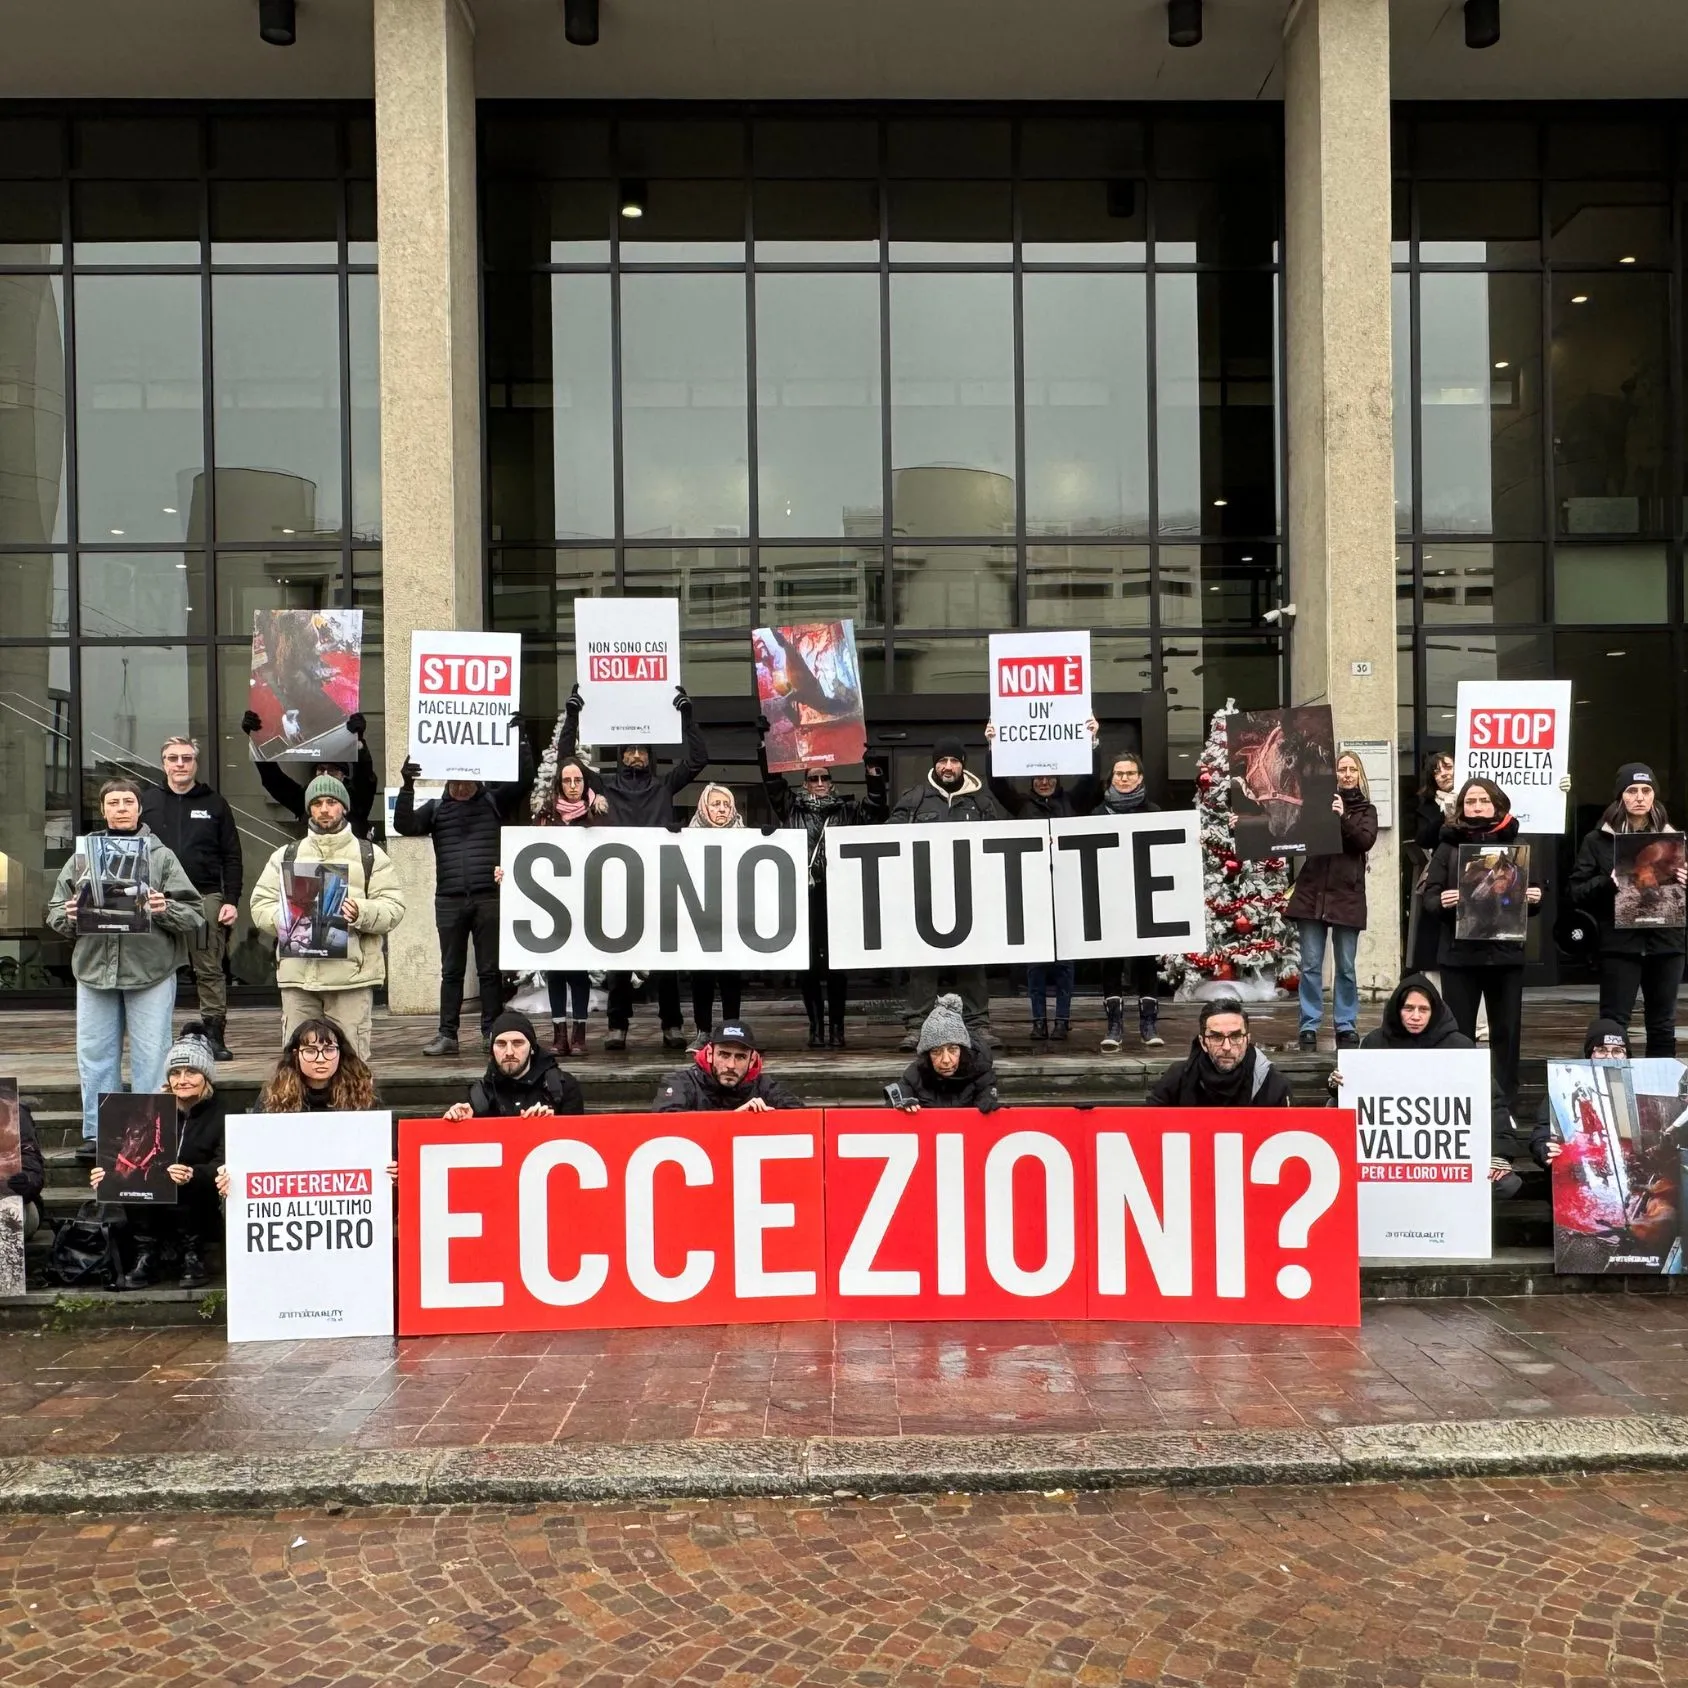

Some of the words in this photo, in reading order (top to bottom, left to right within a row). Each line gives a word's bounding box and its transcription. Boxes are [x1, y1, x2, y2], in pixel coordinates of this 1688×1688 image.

[588, 641, 610, 653] NON
[614, 641, 642, 653] SONO
[645, 641, 668, 653] CASI
[423, 657, 508, 692] STOP
[592, 657, 665, 680] ISOLATI
[1001, 663, 1055, 694] NON
[1063, 655, 1080, 692] È
[418, 700, 512, 716] MACELLAZIONI
[417, 719, 511, 747] CAVALLI
[999, 723, 1084, 742] ECCEZIONE
[1472, 712, 1552, 745] STOP
[1494, 772, 1552, 785] MACELLI
[512, 842, 798, 954] SONO
[839, 828, 1191, 951] TUTTE
[1357, 1096, 1472, 1126] NESSUN
[1358, 1129, 1471, 1159] VALORE
[251, 1172, 369, 1196] SOFFERENZA
[1361, 1166, 1385, 1179] PER
[1388, 1166, 1403, 1179] LE
[1406, 1166, 1438, 1179] LORO
[1441, 1166, 1469, 1180] VITE
[247, 1202, 282, 1218] FINO
[419, 1130, 1341, 1309] ECCEZIONI?
[247, 1218, 373, 1253] RESPIRO
